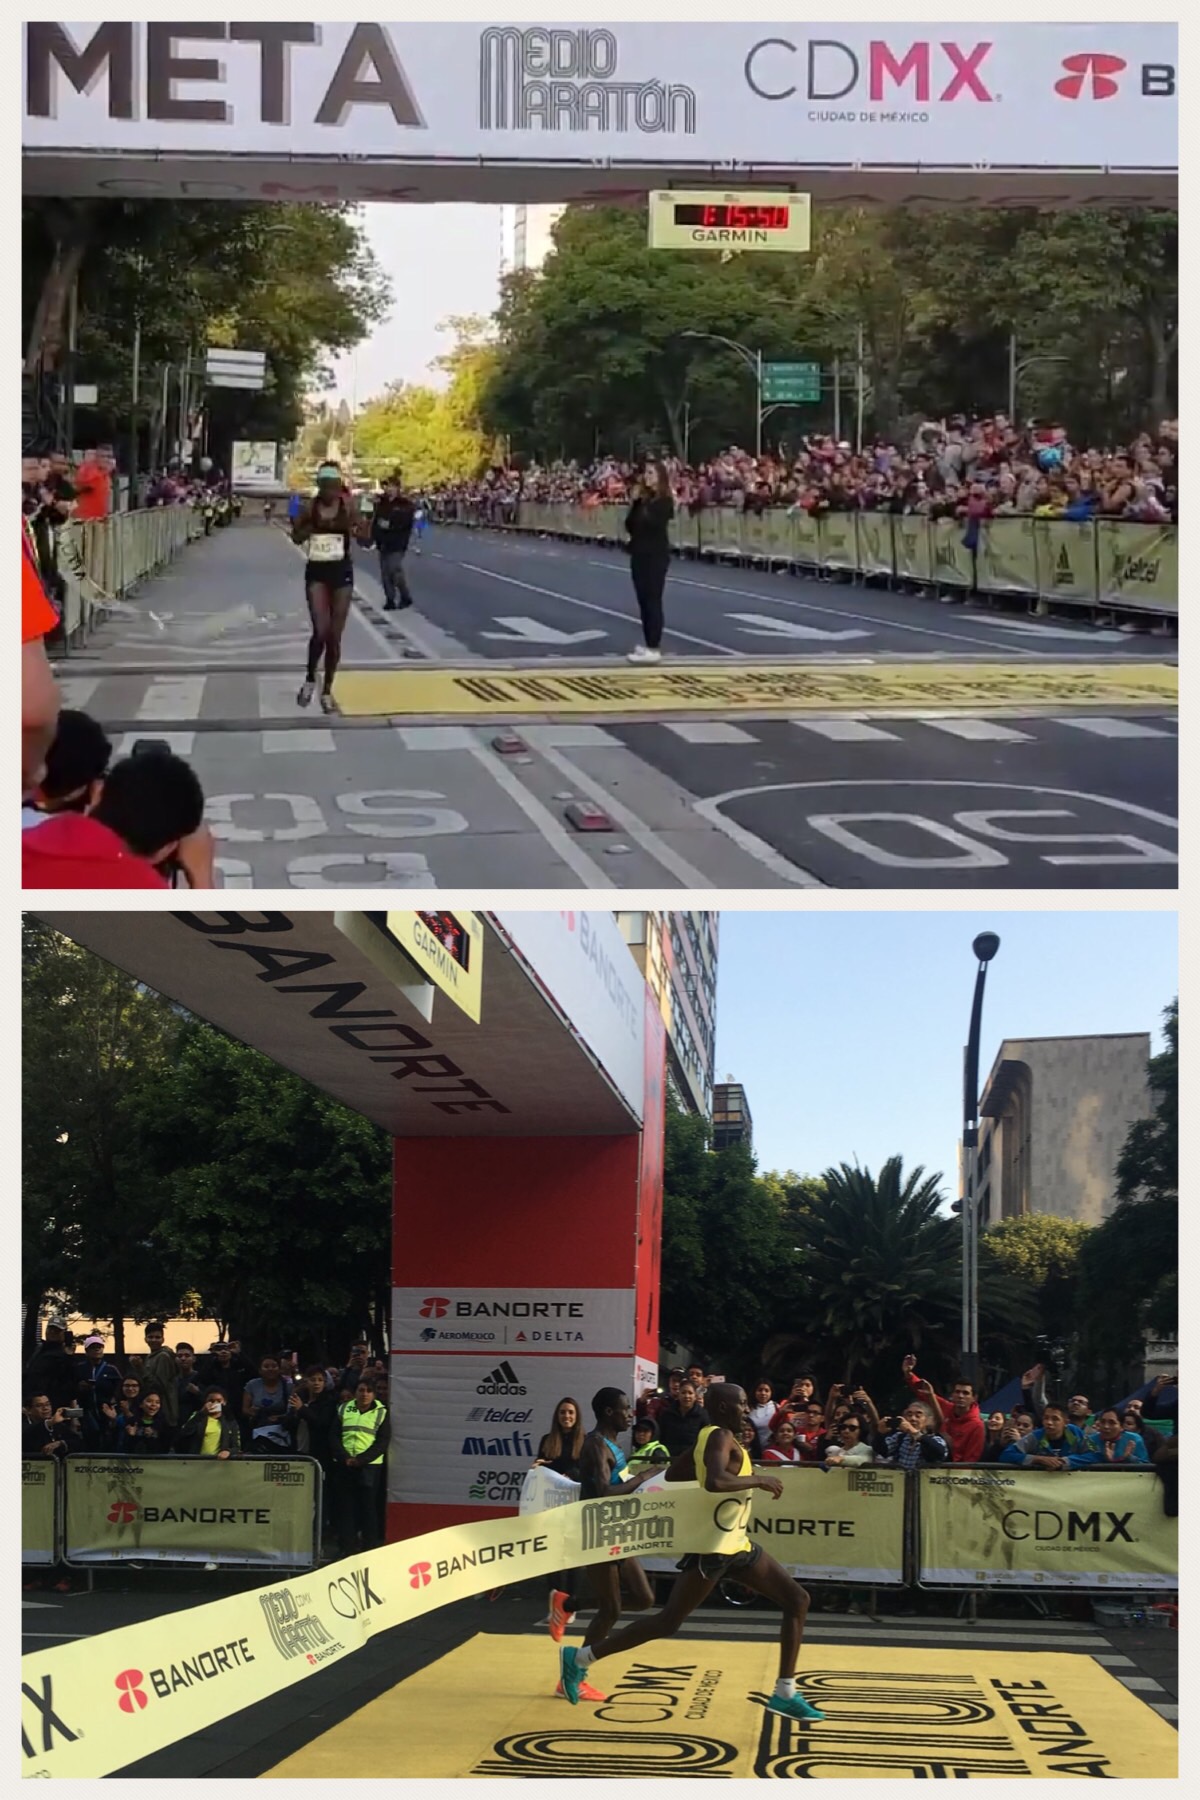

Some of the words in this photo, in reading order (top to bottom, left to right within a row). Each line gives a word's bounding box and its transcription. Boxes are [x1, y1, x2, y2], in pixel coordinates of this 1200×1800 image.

[480, 27, 617, 79] MEDIO
[26, 22, 428, 129] META
[744, 38, 993, 102] CDMX
[808, 111, 856, 122] CIUDAD
[860, 111, 877, 122] DE
[880, 112, 930, 123] MÉXICO
[692, 229, 768, 242] GARMIN
[413, 920, 459, 988] GARMIN
[456, 1302, 584, 1318] BANORTE
[532, 1332, 584, 1341] DELTA
[476, 1383, 527, 1396] adidas
[483, 1408, 534, 1423] telcel
[477, 1470, 527, 1485] SPORT
[488, 1486, 522, 1501] CITY
[643, 1501, 676, 1512] CDMX
[144, 1507, 270, 1524] BANORTE
[747, 1517, 855, 1537] NORTE
[1002, 1509, 1134, 1542] CDMX
[622, 1541, 674, 1553] BANORTE
[436, 1535, 548, 1579] BANORTE
[314, 1642, 345, 1661] BANORTE
[150, 1637, 255, 1698] BANORTE
[594, 1663, 697, 1723] CDMX
